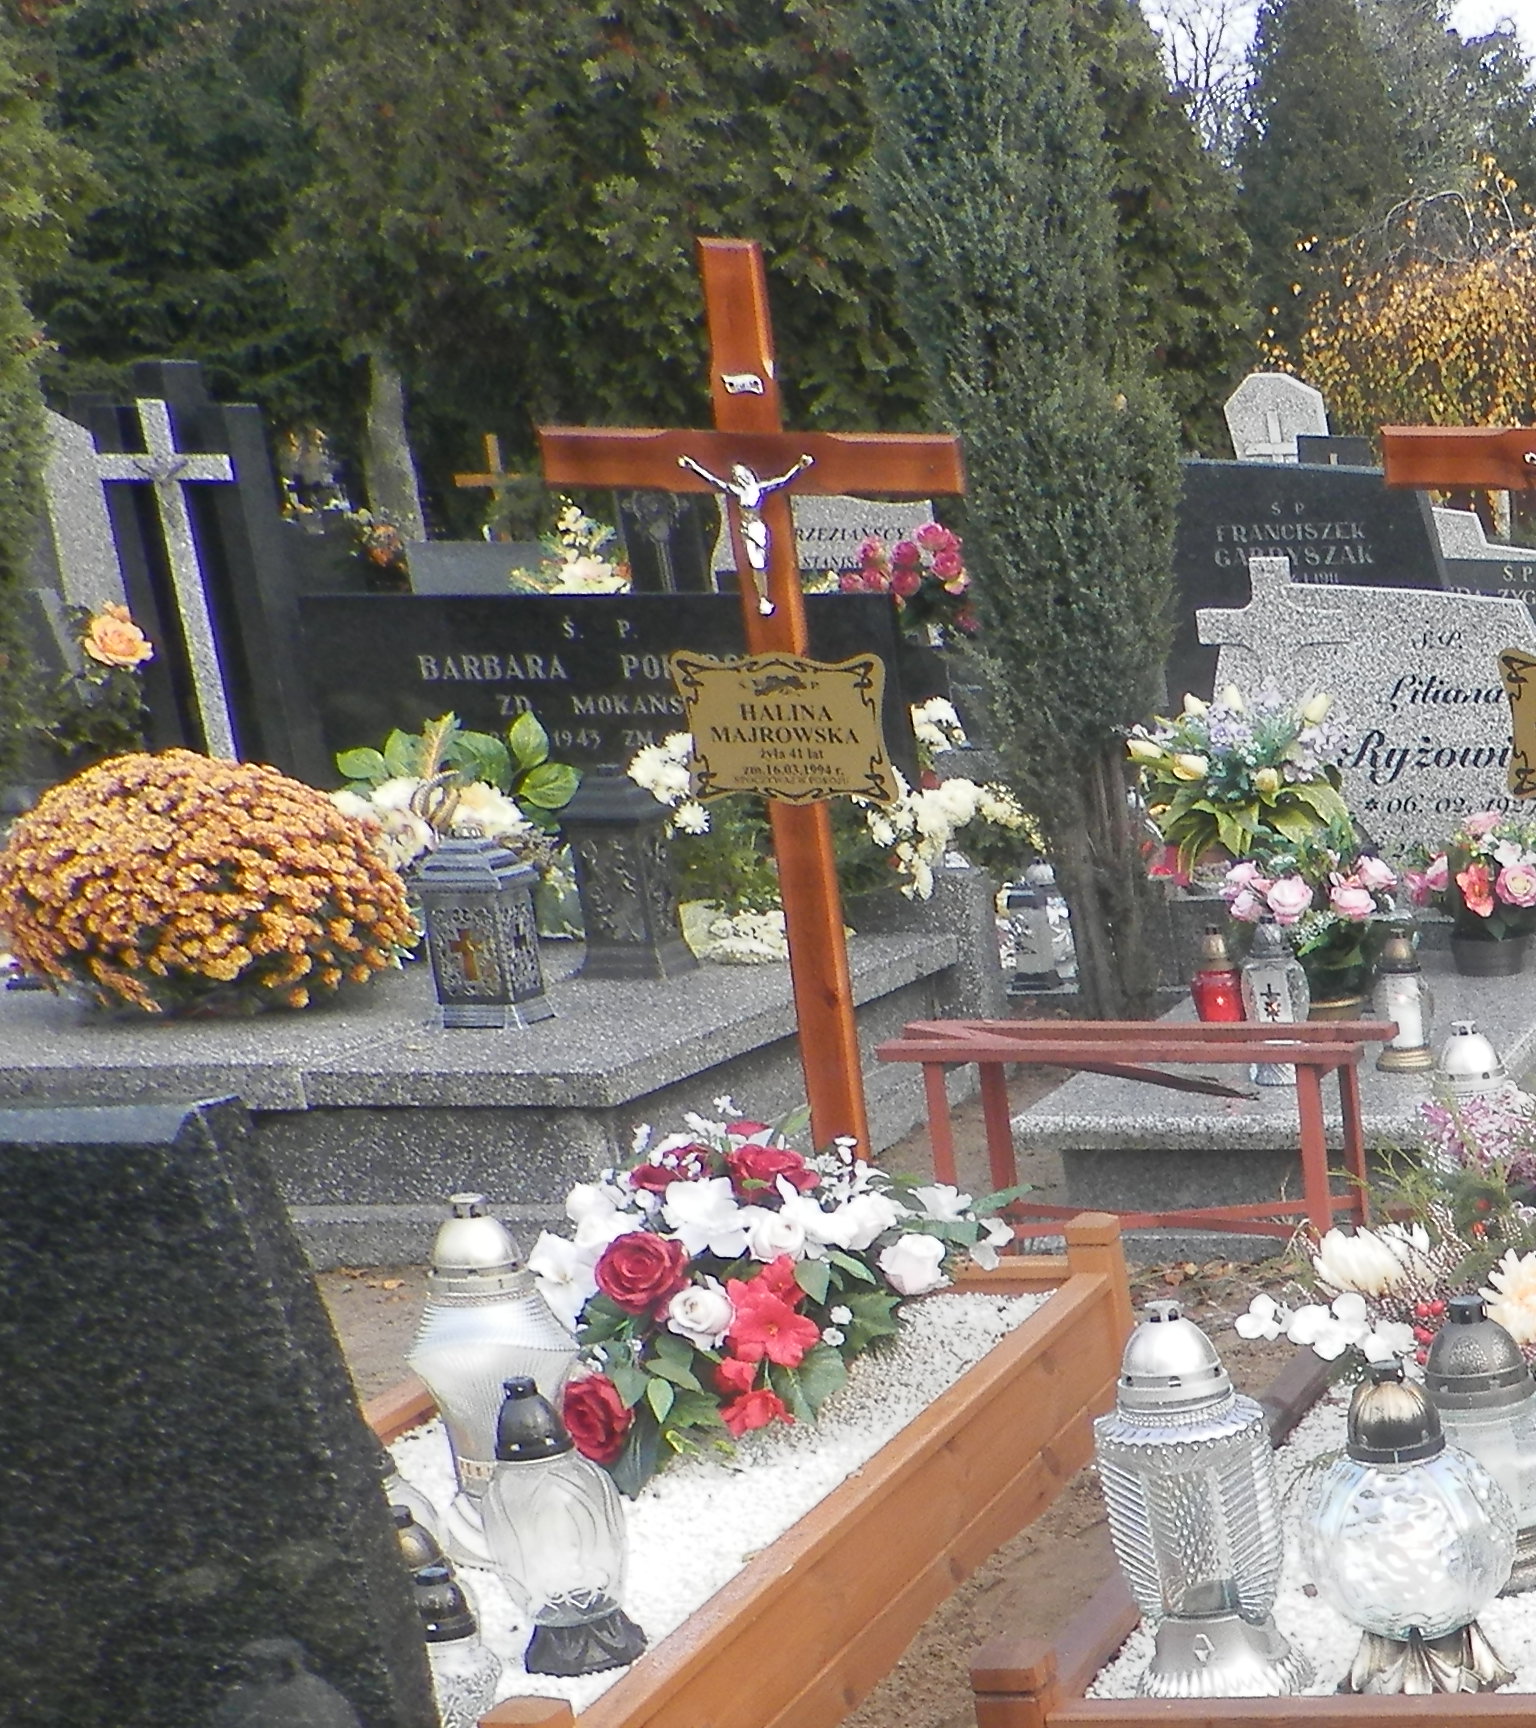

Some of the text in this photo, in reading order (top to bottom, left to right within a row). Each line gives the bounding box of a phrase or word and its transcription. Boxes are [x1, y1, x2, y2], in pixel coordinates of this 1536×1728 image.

[1215, 521, 1366, 543] FRANCISZEK
[417, 654, 568, 680] BARBARA
[740, 703, 833, 721] HALINA
[710, 725, 859, 744] MAJROWSKA
[1337, 729, 1514, 786] Ryżowi
